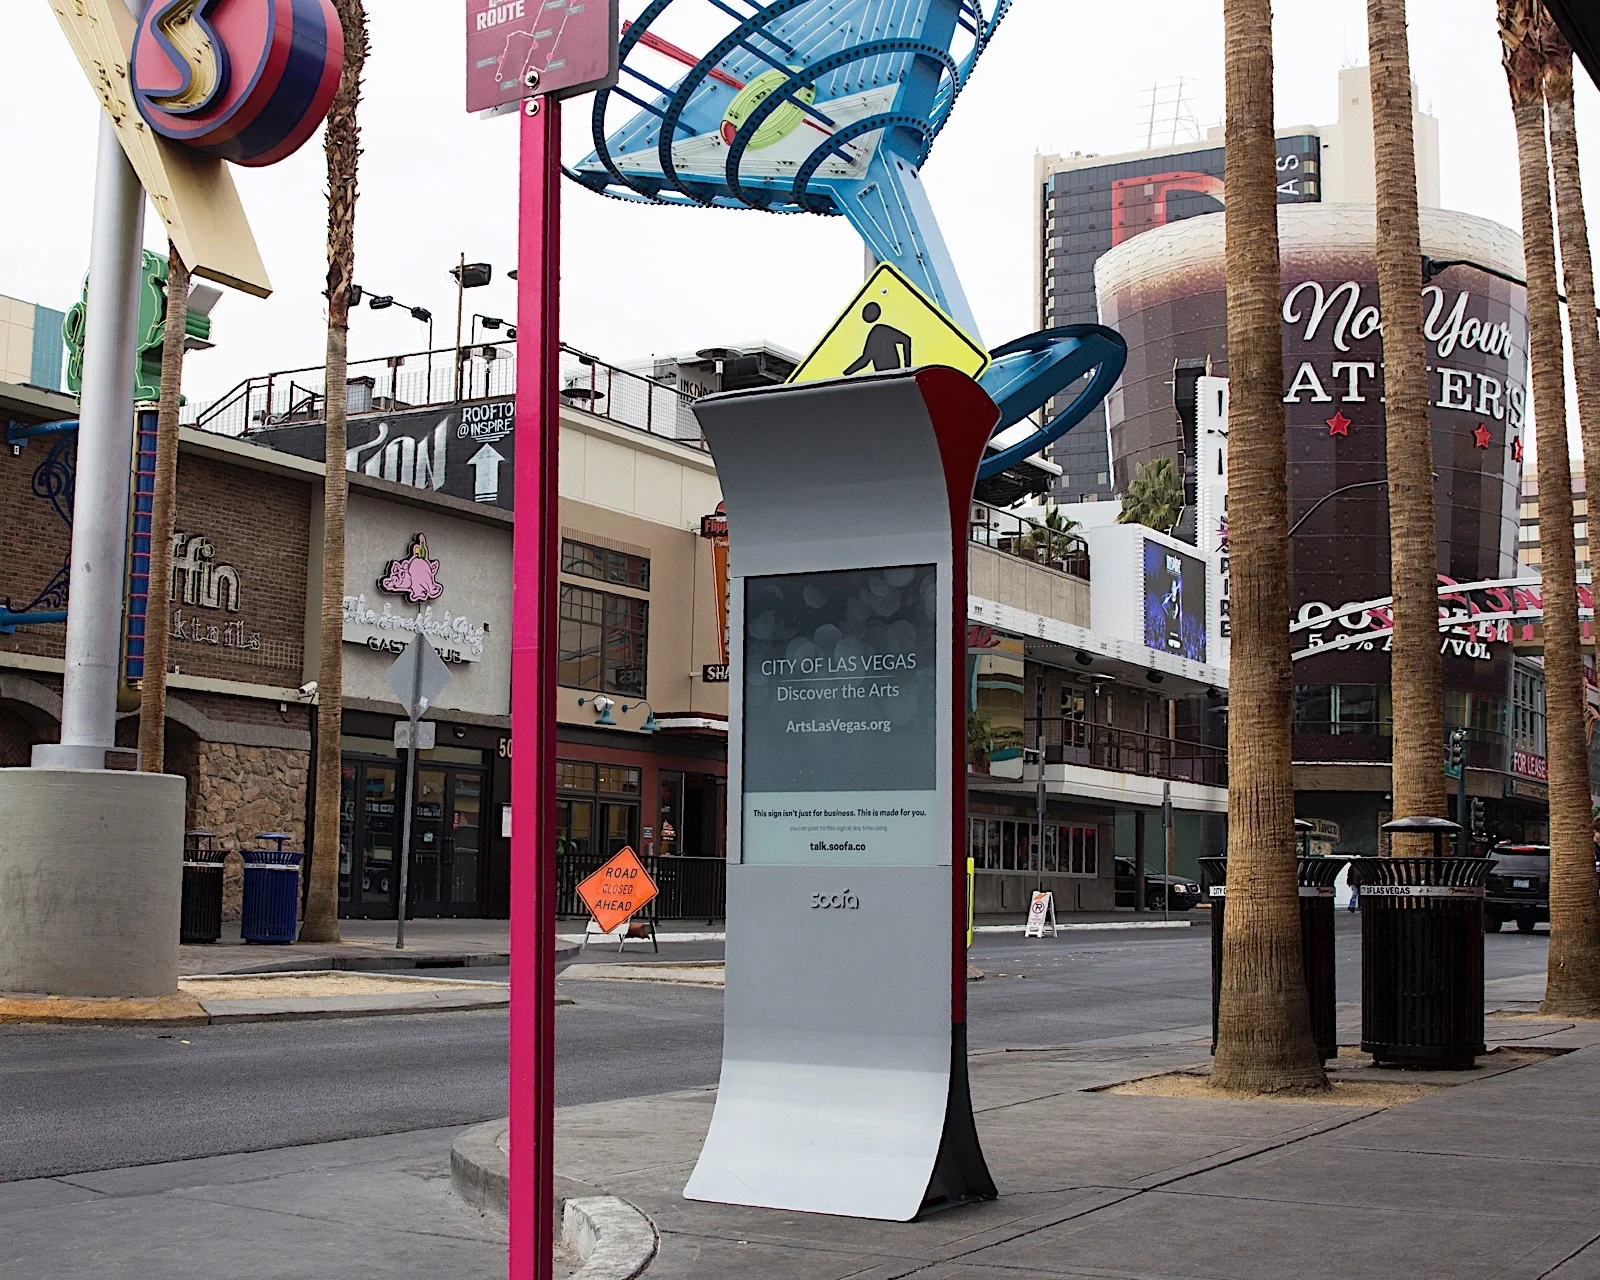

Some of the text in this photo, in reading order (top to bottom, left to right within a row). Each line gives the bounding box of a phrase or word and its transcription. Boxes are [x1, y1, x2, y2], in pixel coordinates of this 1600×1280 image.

[476, 0, 525, 31] ROUTE
[1282, 280, 1514, 360] No Your
[1283, 361, 1526, 429] ATER'S
[462, 401, 516, 422] ROOFTO
[761, 653, 917, 676] CITY OF LAS VEGAS
[777, 682, 900, 701] Discover the Arts
[785, 718, 891, 734] ArtsLasVegas.org
[1514, 751, 1546, 779] FOR LEASE
[753, 808, 927, 818] This sign isn't just for business. This is made for you.
[809, 840, 866, 851] talk.soofa.co
[605, 867, 638, 879] ROAD
[602, 883, 633, 895] CLOSED
[1373, 886, 1385, 895] LAS
[1385, 886, 1411, 895] VEGAS
[594, 899, 632, 912] AHEAD
